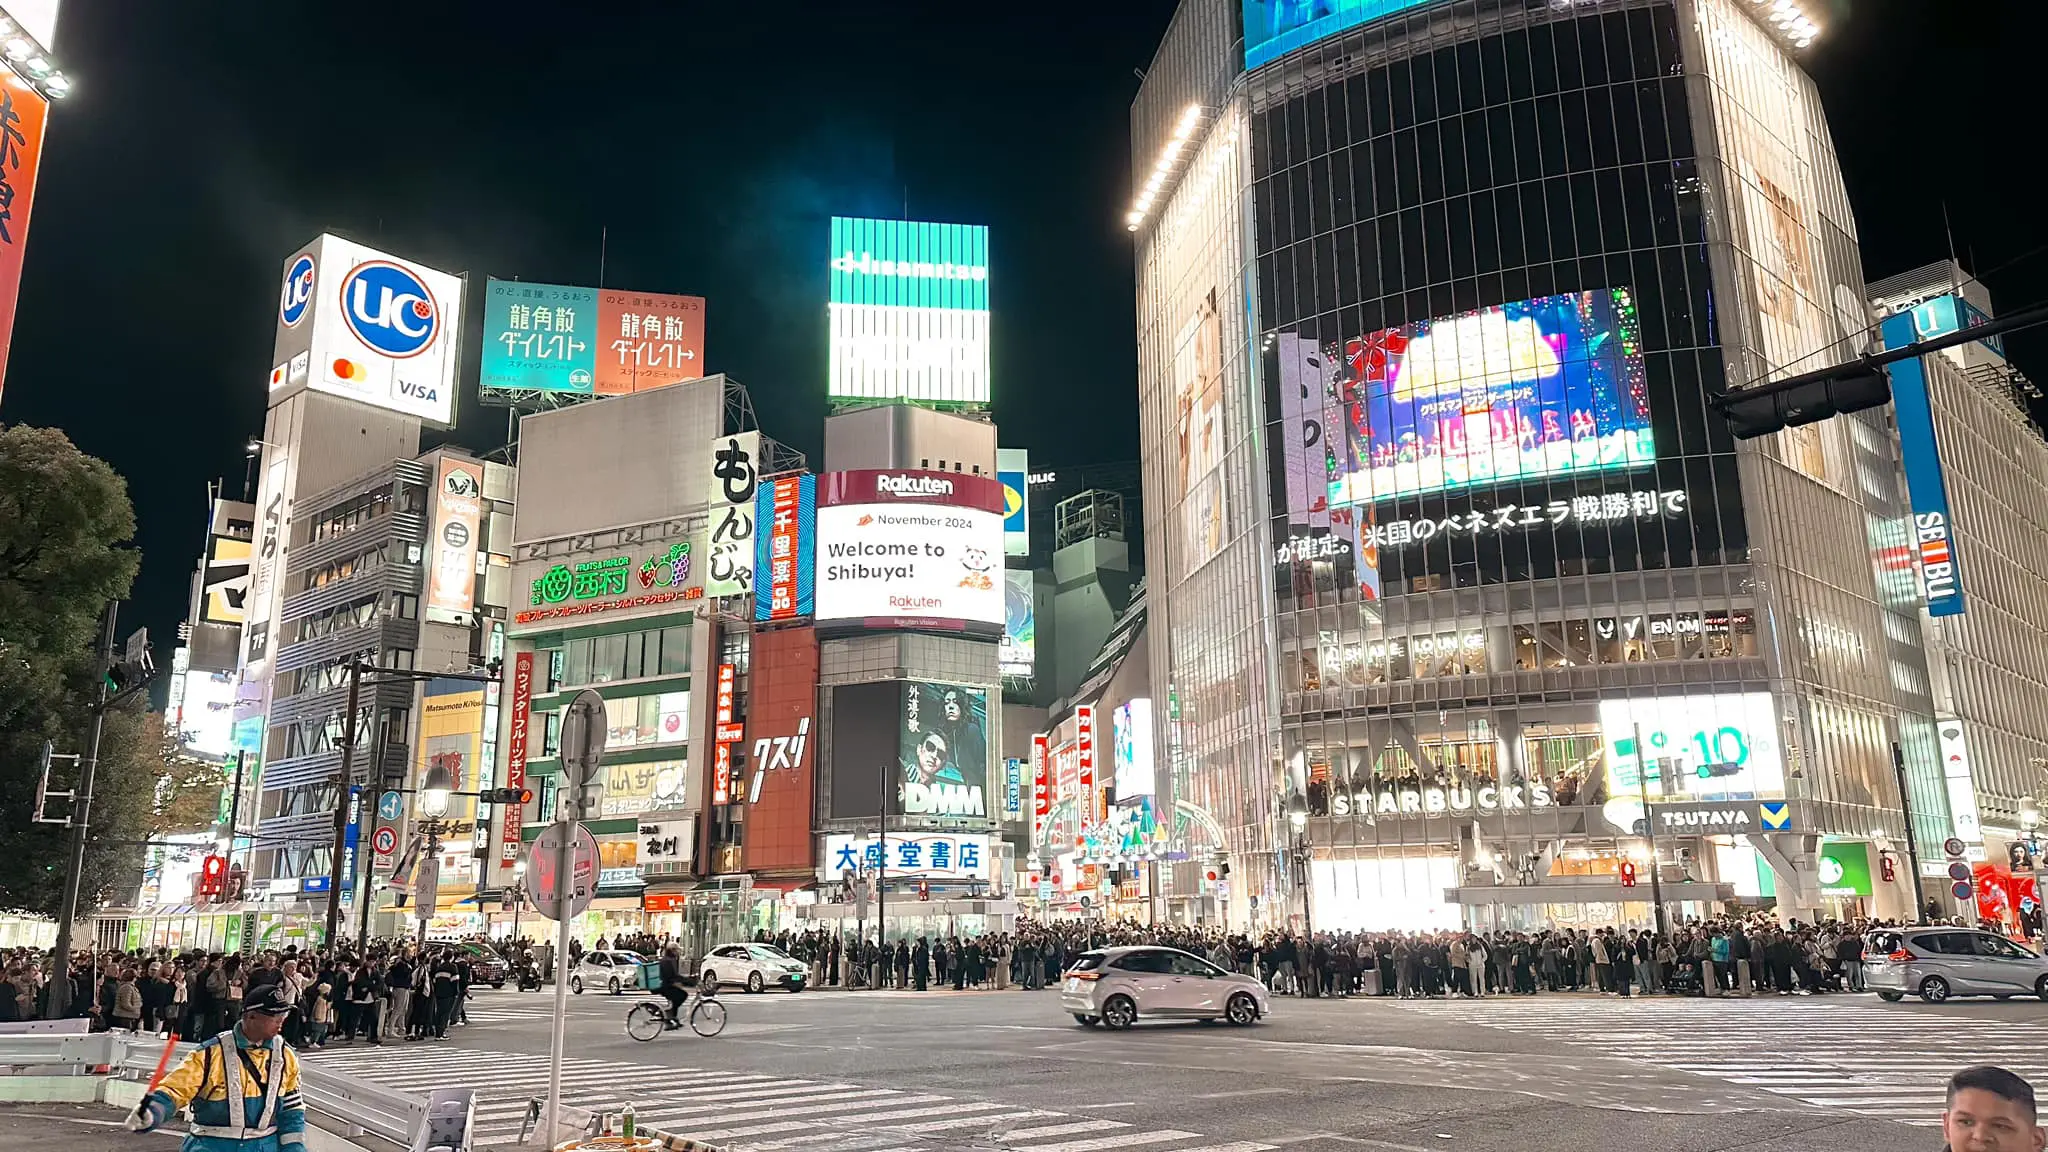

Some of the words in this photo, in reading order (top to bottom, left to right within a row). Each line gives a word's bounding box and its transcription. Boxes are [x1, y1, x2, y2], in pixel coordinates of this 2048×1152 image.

[510, 304, 575, 333] 龍角散
[621, 313, 684, 341] 龍角散
[499, 332, 586, 360] ダイレクト
[610, 340, 695, 368] ダイレクト
[399, 380, 438, 402] VISA
[878, 474, 954, 497] Rakuten
[710, 439, 756, 590] もんじゃ
[878, 515, 941, 527] November
[944, 517, 973, 529] 2024
[771, 483, 793, 610] 三千里薬品
[828, 541, 919, 558] Welcome
[924, 543, 945, 557] to
[573, 567, 629, 599] 西村
[827, 564, 915, 581] Shibuya!
[889, 595, 942, 609] Rakuten
[252, 632, 266, 650] 7F
[425, 702, 463, 712] Matsumoto
[1079, 715, 1091, 777] カラオケ
[905, 782, 985, 815] DMM
[1334, 786, 1554, 815] STARBUCKS
[1661, 810, 1750, 826] TSUTAYA
[836, 841, 980, 871] 大盛堂書店
[242, 913, 255, 959] SMOKIN
